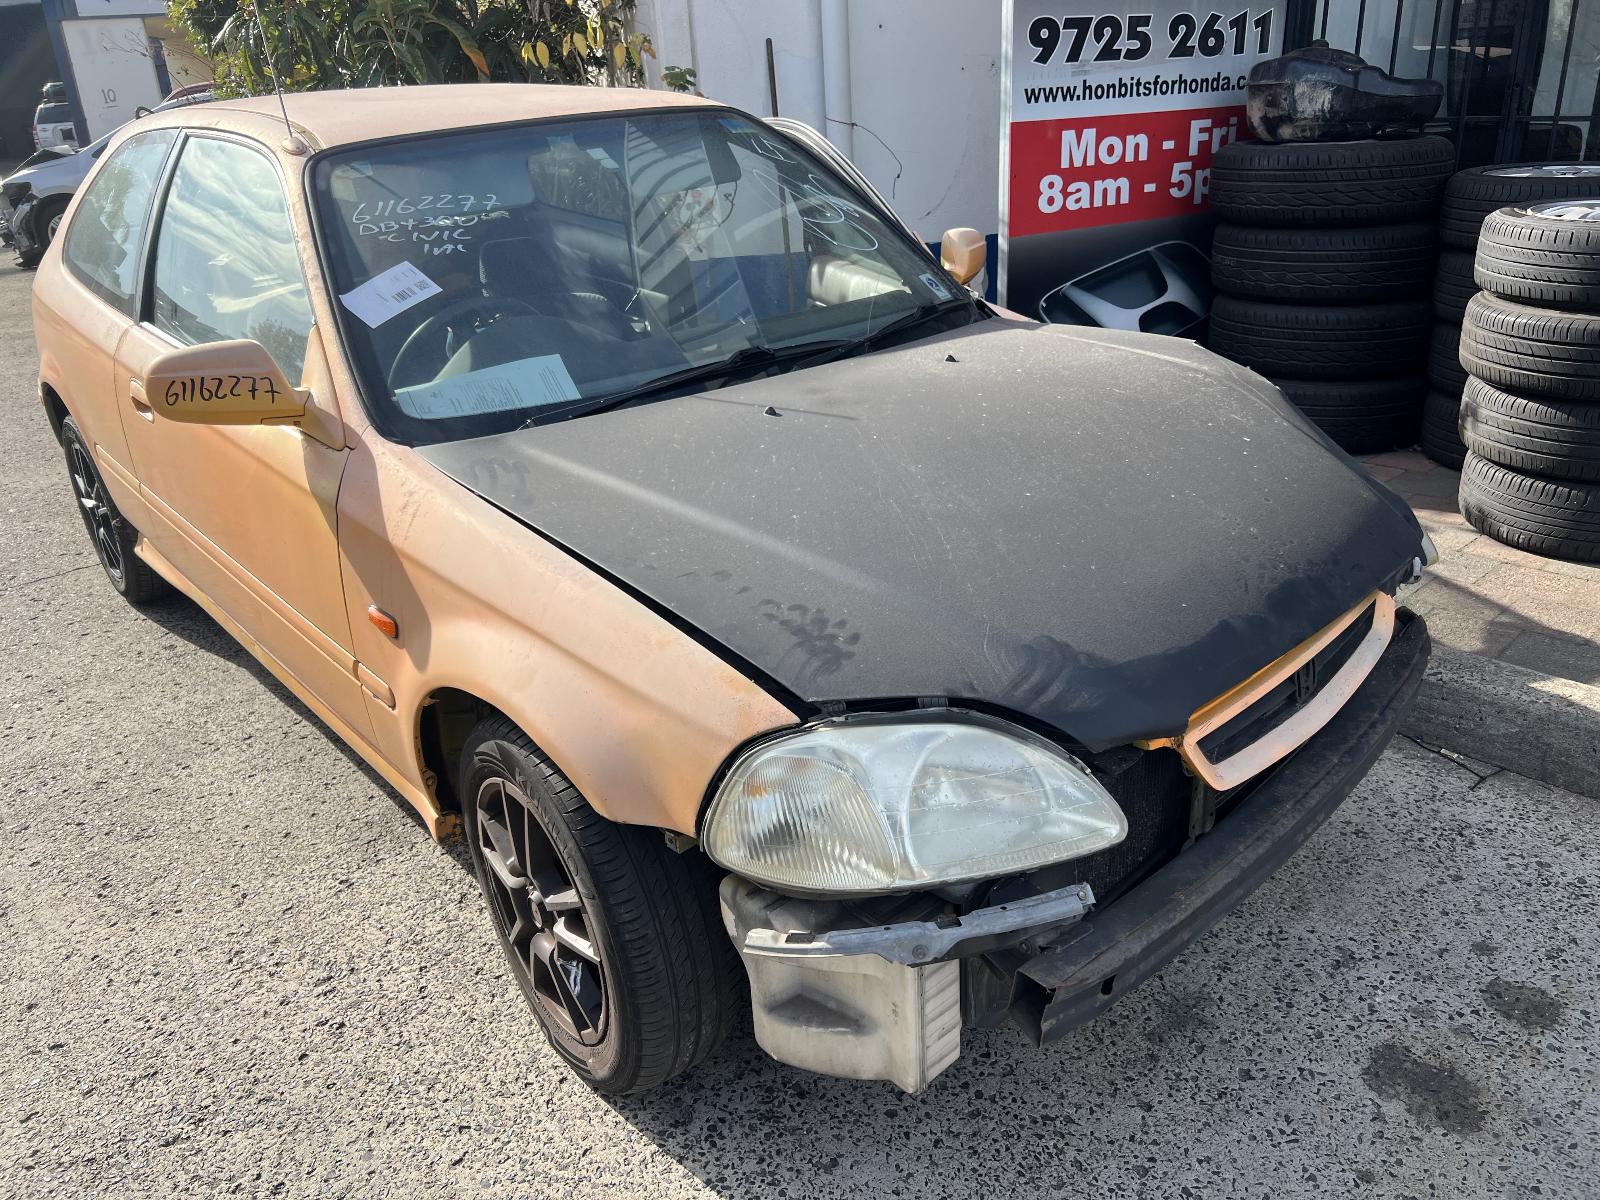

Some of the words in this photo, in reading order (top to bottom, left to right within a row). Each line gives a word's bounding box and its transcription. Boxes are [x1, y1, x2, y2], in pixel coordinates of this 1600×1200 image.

[1028, 14, 1153, 66] 9725
[1167, 8, 1274, 59] 2611
[1061, 128, 1149, 169] Mon
[1188, 116, 1238, 157] Fri
[352, 194, 501, 223] 61162277
[1038, 174, 1130, 214] 8am
[165, 375, 282, 407] 61162277
